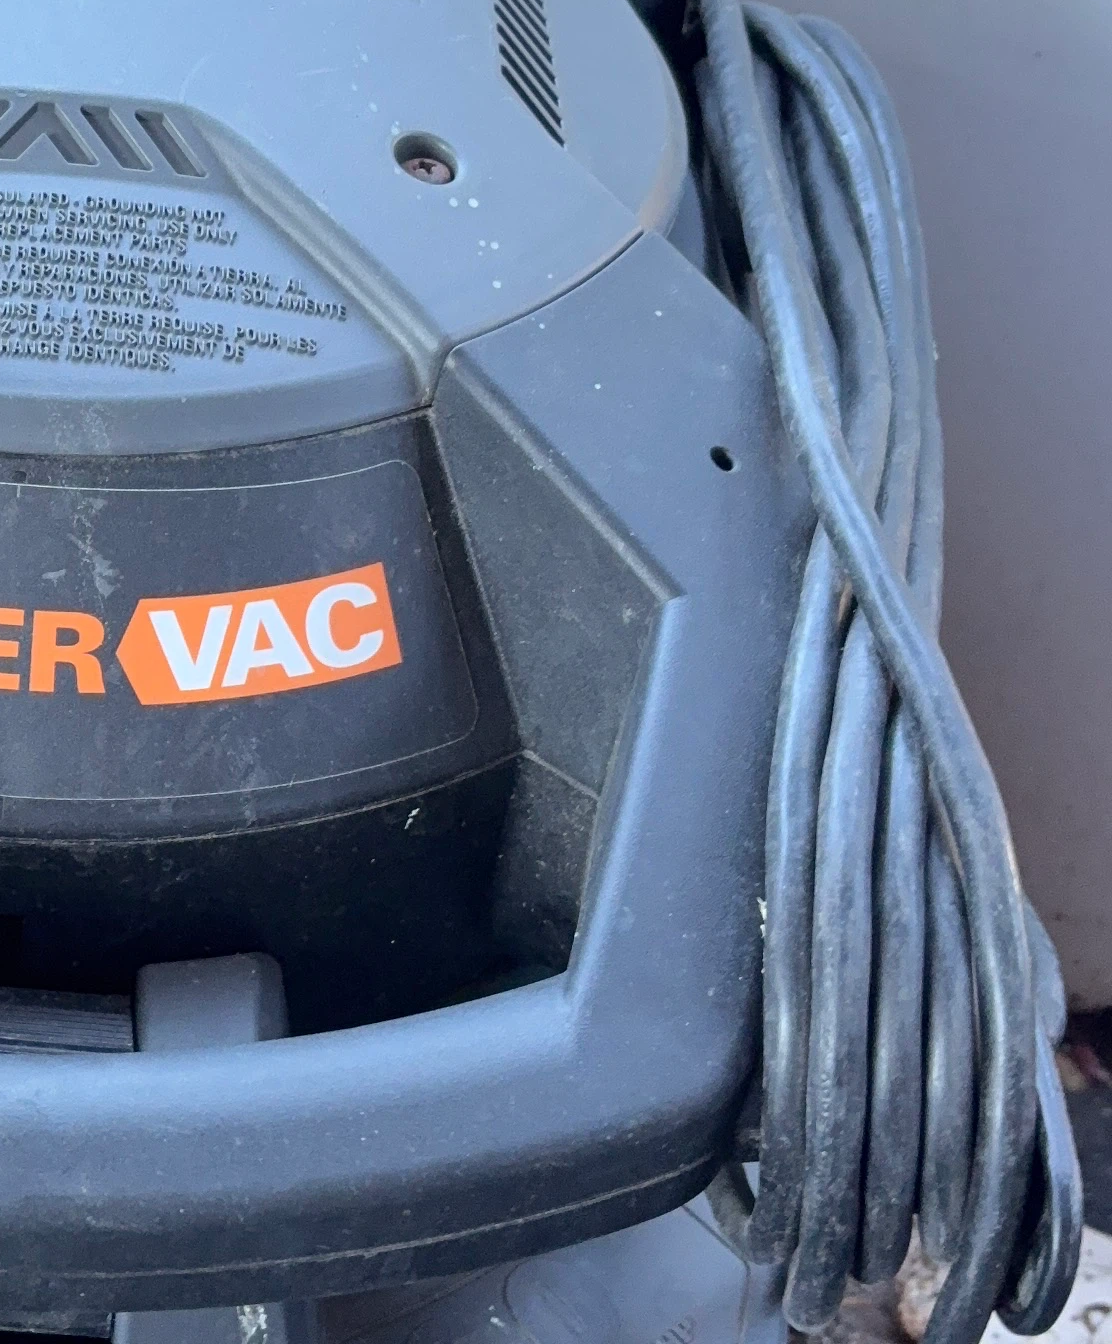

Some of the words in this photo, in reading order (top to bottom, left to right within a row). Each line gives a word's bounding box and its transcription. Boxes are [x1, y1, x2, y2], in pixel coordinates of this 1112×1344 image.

[86, 195, 188, 222] GROUNDING
[190, 207, 225, 227] NOT
[156, 220, 190, 236] USE
[194, 224, 238, 246] ONLY
[16, 246, 100, 267] REQUIERE
[194, 265, 207, 280] A
[284, 278, 307, 296] AL
[157, 275, 236, 303] UTILIZAR
[240, 288, 348, 322] SOLAMENTE
[60, 306, 83, 326] LA
[86, 307, 144, 330] TERRE
[234, 325, 283, 349] POUR
[287, 334, 318, 357] LES
[69, 324, 218, 357] EXCLUSIVEMENT
[222, 341, 246, 364] DE
[147, 581, 385, 692] VAC
